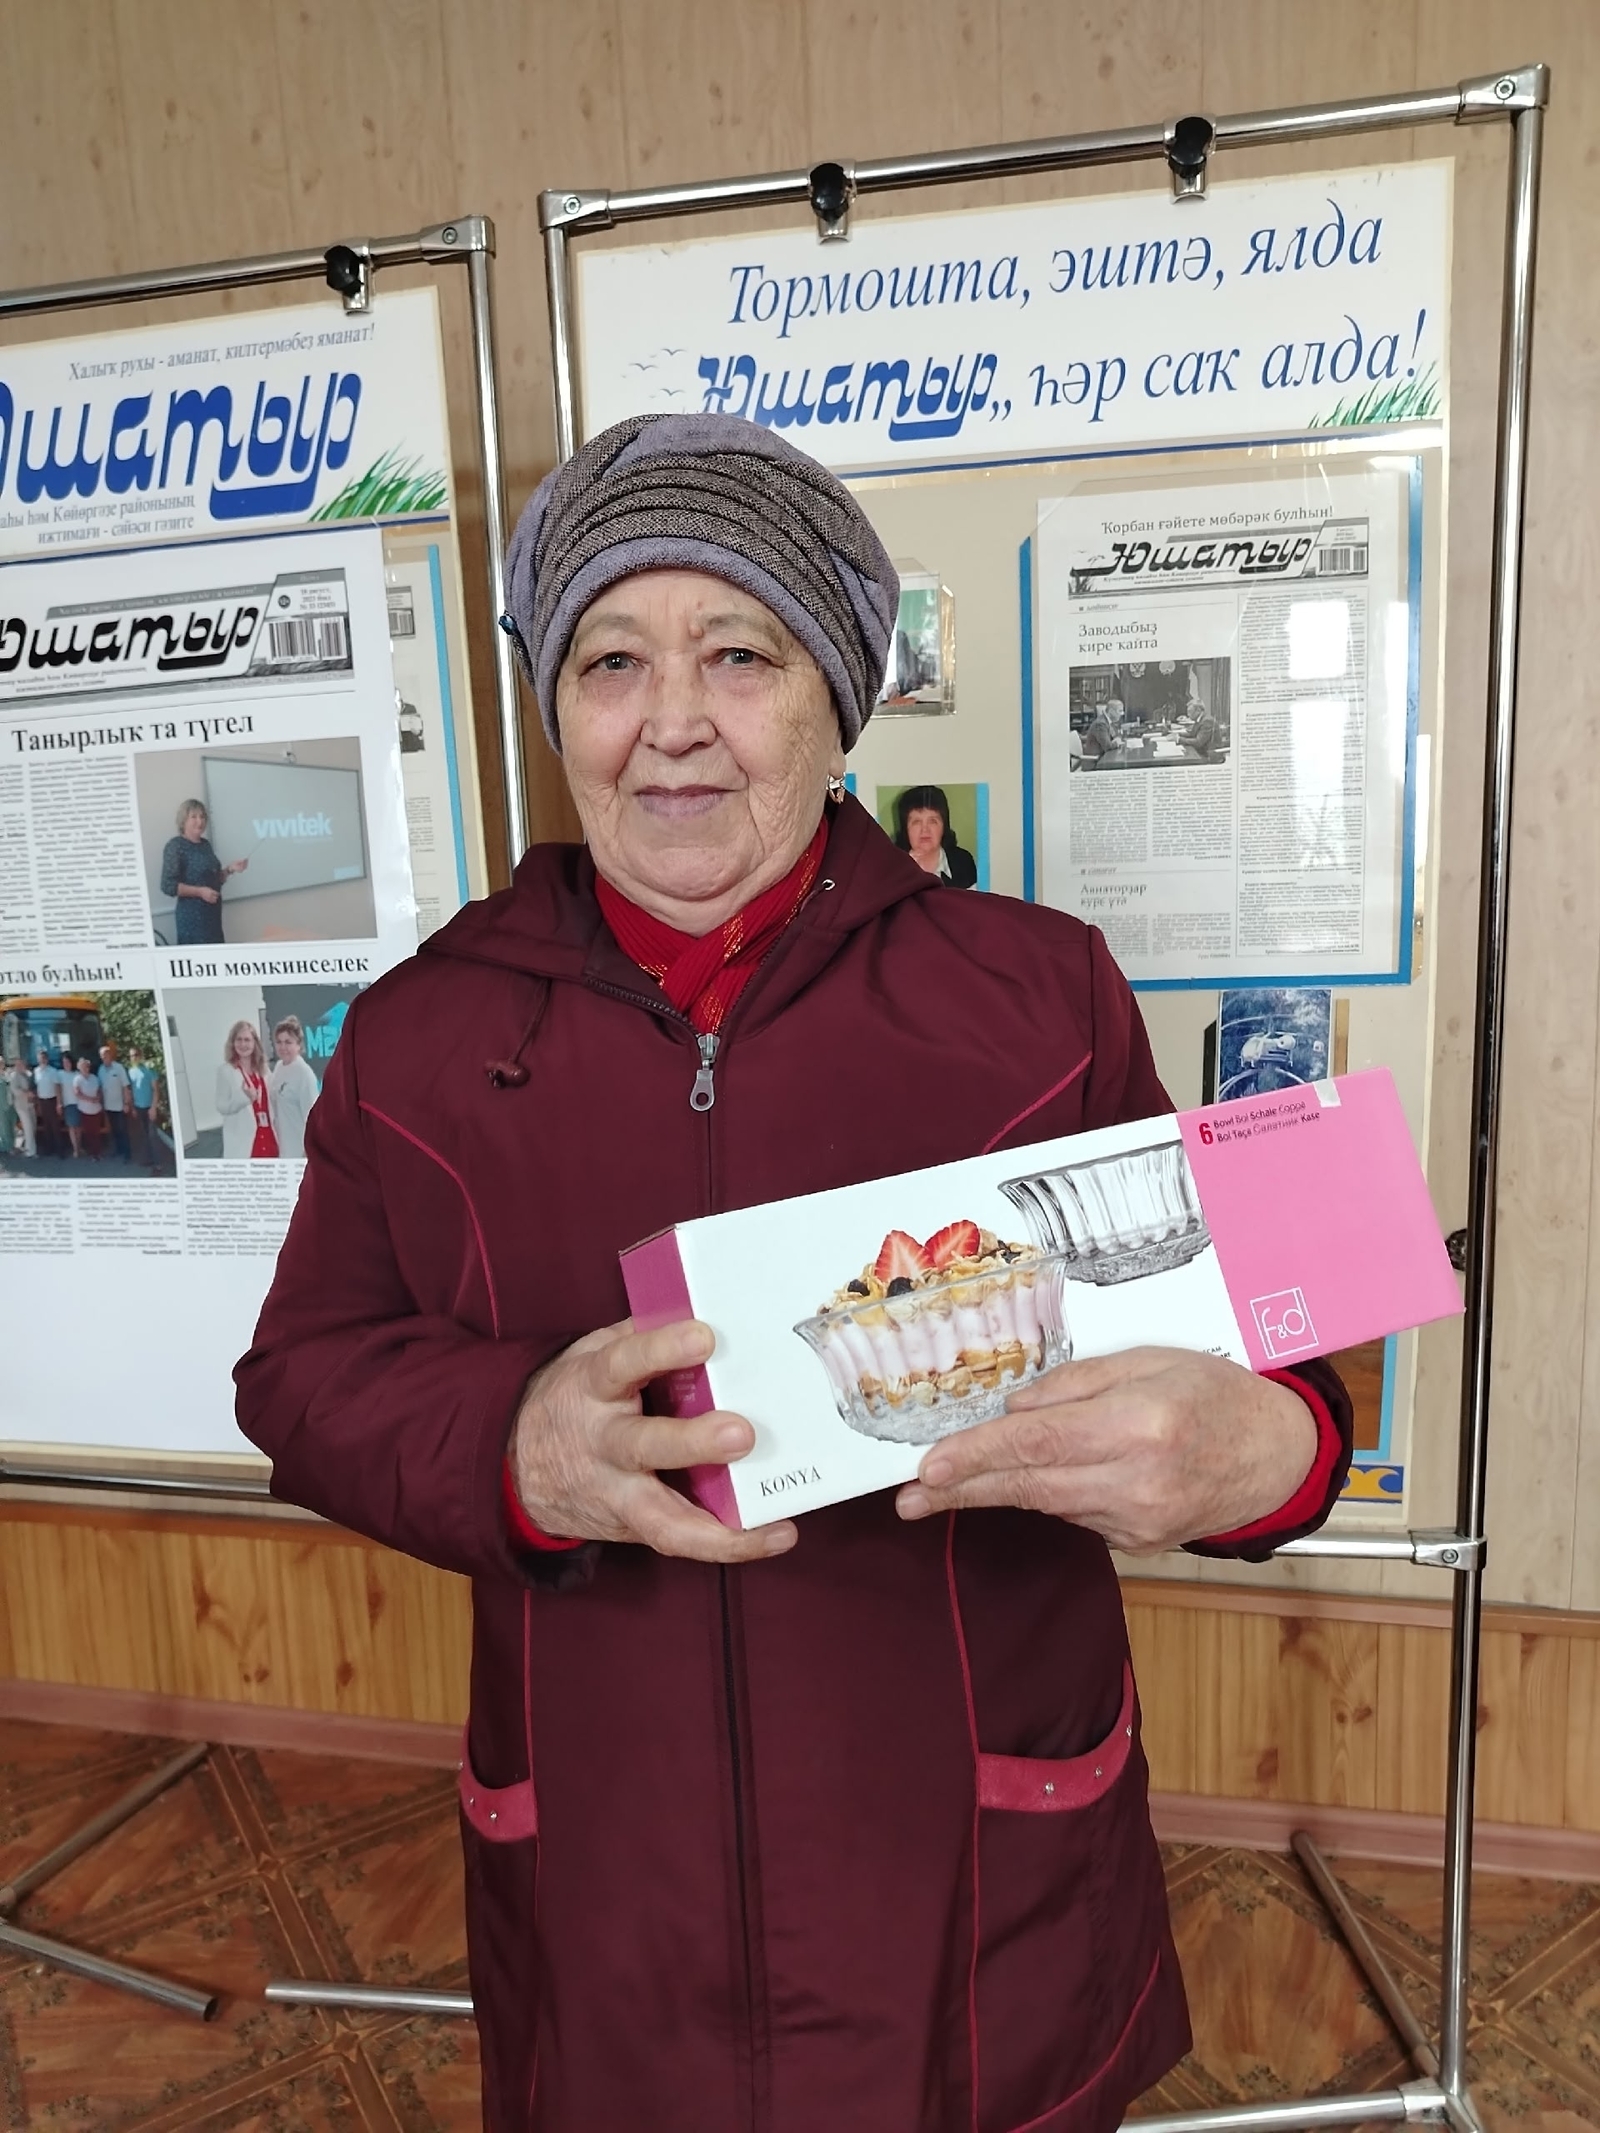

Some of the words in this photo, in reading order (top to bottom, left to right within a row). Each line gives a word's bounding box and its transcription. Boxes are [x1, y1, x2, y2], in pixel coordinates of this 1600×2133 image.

[728, 256, 1031, 339] Тормошта,
[1048, 236, 1225, 293] эштә,
[1240, 199, 1383, 276] ялда
[120, 355, 156, 378] рухы
[167, 348, 221, 368] аманат,
[316, 323, 375, 347] яманат!
[1028, 356, 1127, 423] һәр
[1261, 309, 1427, 390] алда!
[1209, 511, 1270, 527] мөбәрәк
[1274, 505, 1334, 524] булһын!
[1070, 538, 1312, 577] Юшатыр
[150, 722, 177, 740] та
[184, 715, 255, 743] түгел
[252, 812, 333, 838] vivitek
[42, 962, 123, 988] булһын!
[170, 958, 218, 978] Шәп
[225, 957, 369, 977] мөмкинселек
[1213, 1117, 1235, 1129] Bowl
[1236, 1113, 1249, 1124] Bol
[1250, 1107, 1277, 1121] Schale
[1216, 1131, 1232, 1143] Bol
[1301, 1111, 1320, 1123] Kase
[1199, 1122, 1214, 1145] 6
[760, 1466, 822, 1497] KONYA
